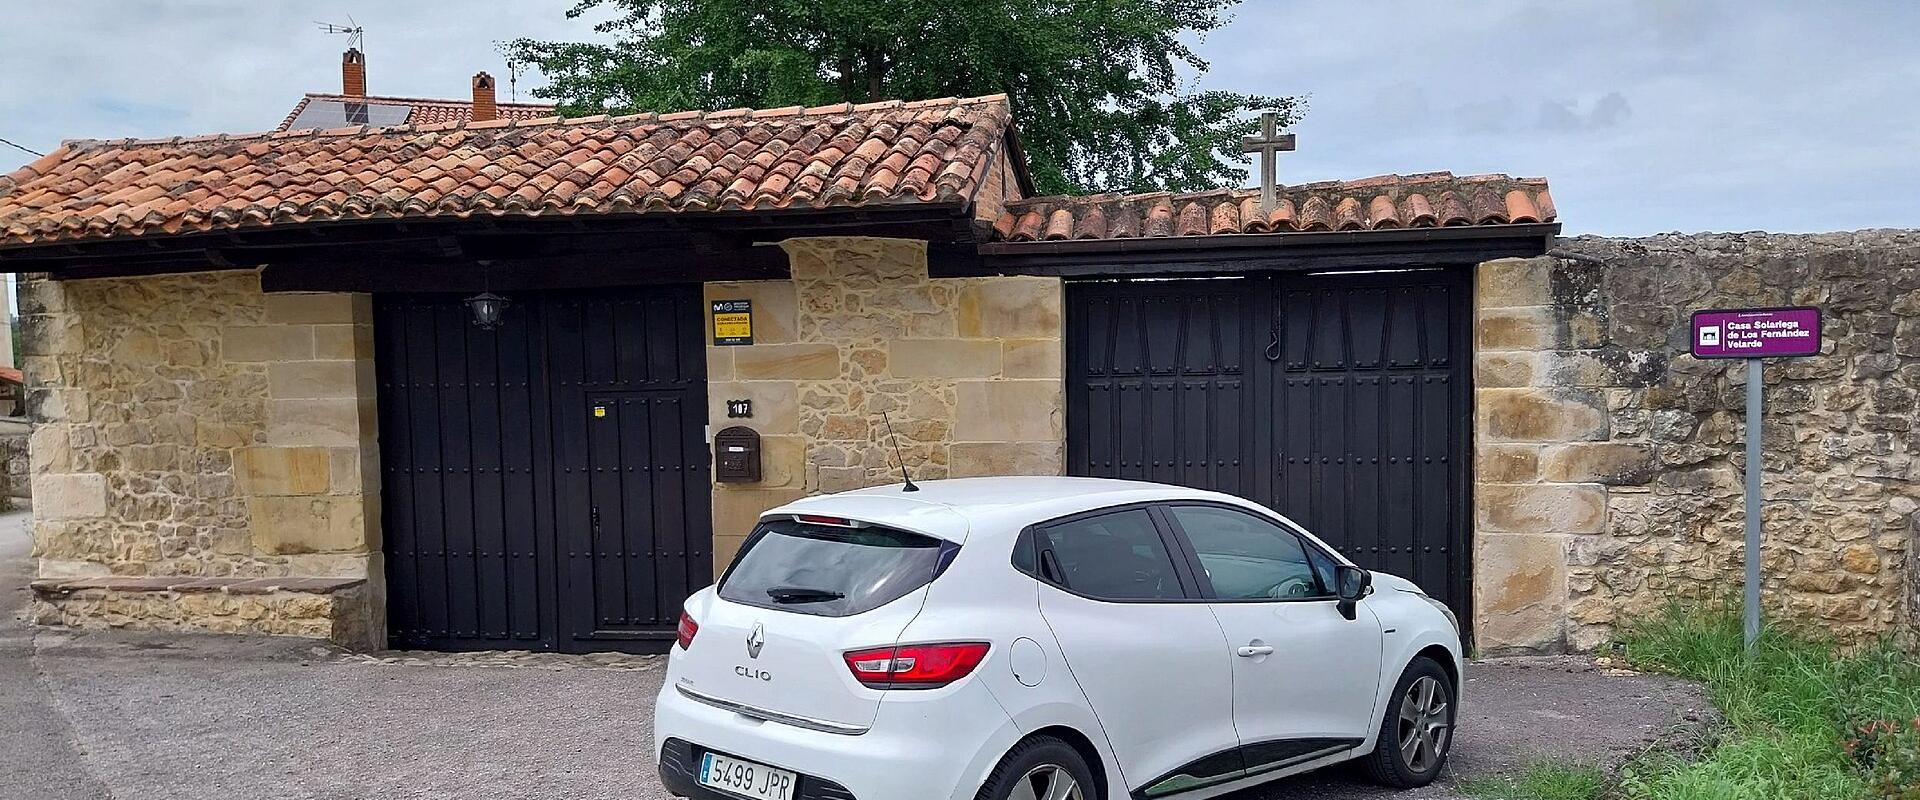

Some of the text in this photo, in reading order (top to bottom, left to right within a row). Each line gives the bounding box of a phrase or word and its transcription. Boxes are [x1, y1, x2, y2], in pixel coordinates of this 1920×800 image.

[1727, 320, 1799, 330] Casa Solariega
[1727, 329, 1810, 339] de Los Fernández
[1727, 340, 1763, 348] Velarde
[735, 665, 771, 681] CLIO
[713, 760, 790, 800] 5499 JPR
